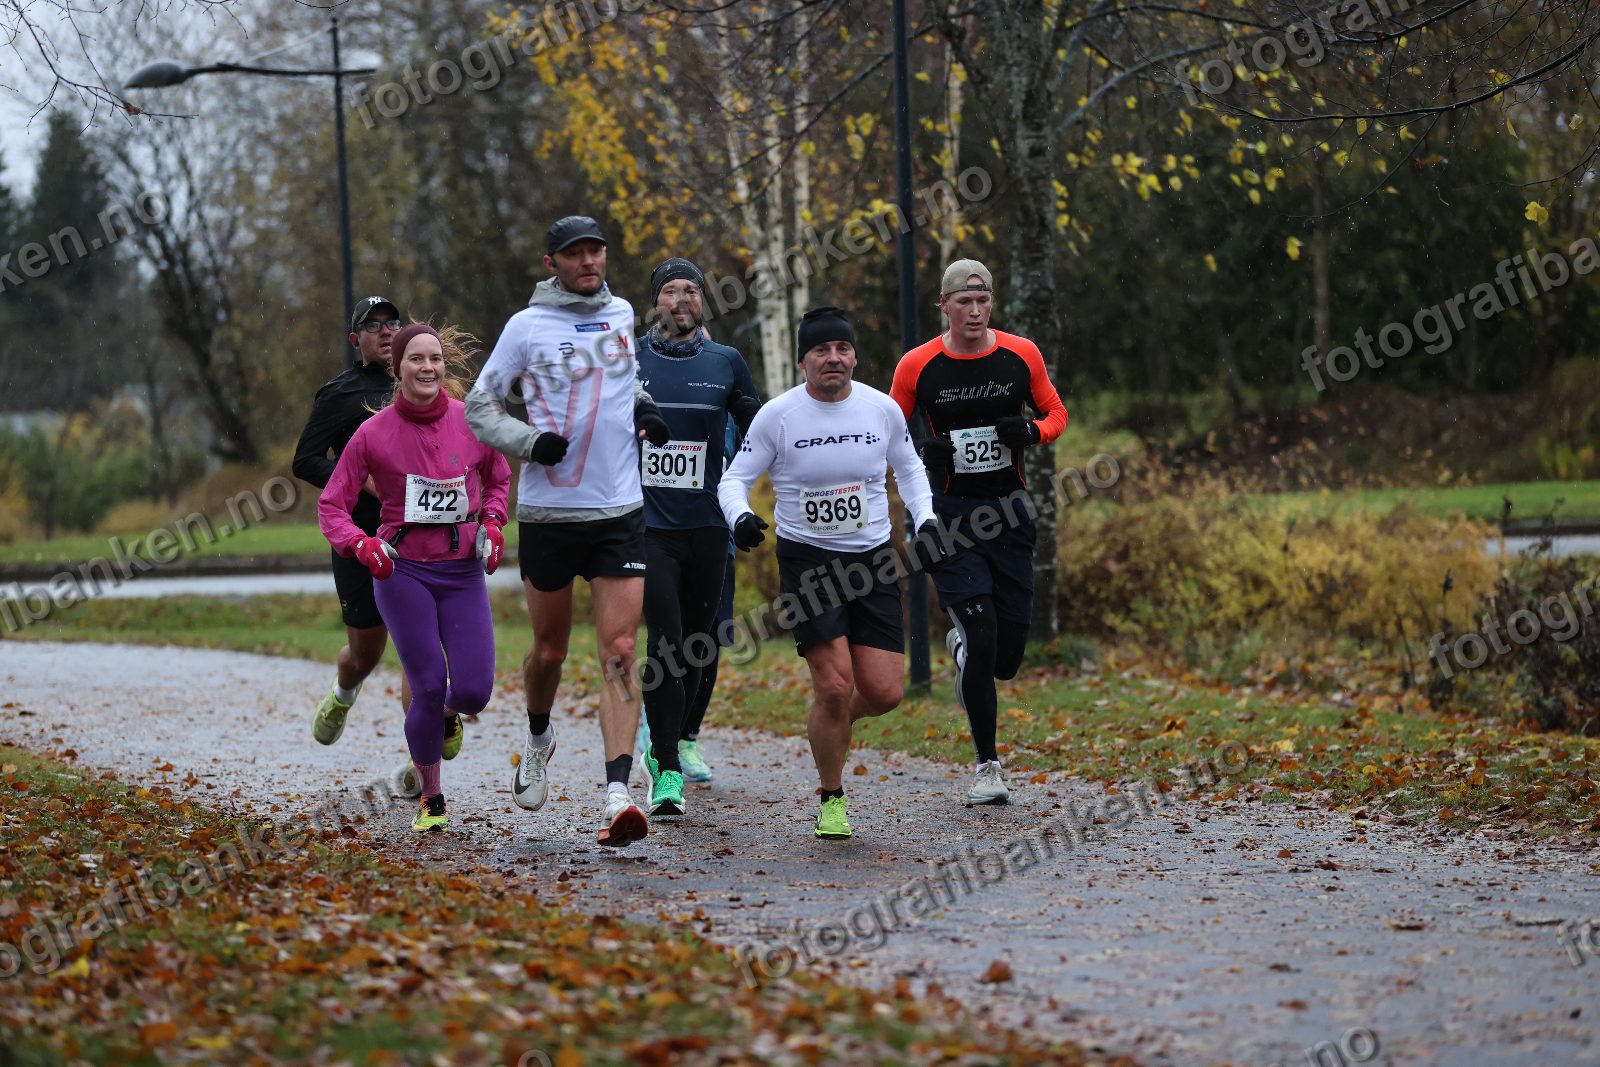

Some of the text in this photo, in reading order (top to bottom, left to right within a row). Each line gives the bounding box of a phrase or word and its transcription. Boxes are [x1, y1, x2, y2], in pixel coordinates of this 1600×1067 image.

[794, 435, 863, 448] CRAFT
[965, 441, 1002, 464] 525
[647, 452, 697, 477] 3001
[417, 489, 458, 512] 422
[803, 485, 861, 498] NORGESTESTEN
[805, 495, 861, 524] 9369
